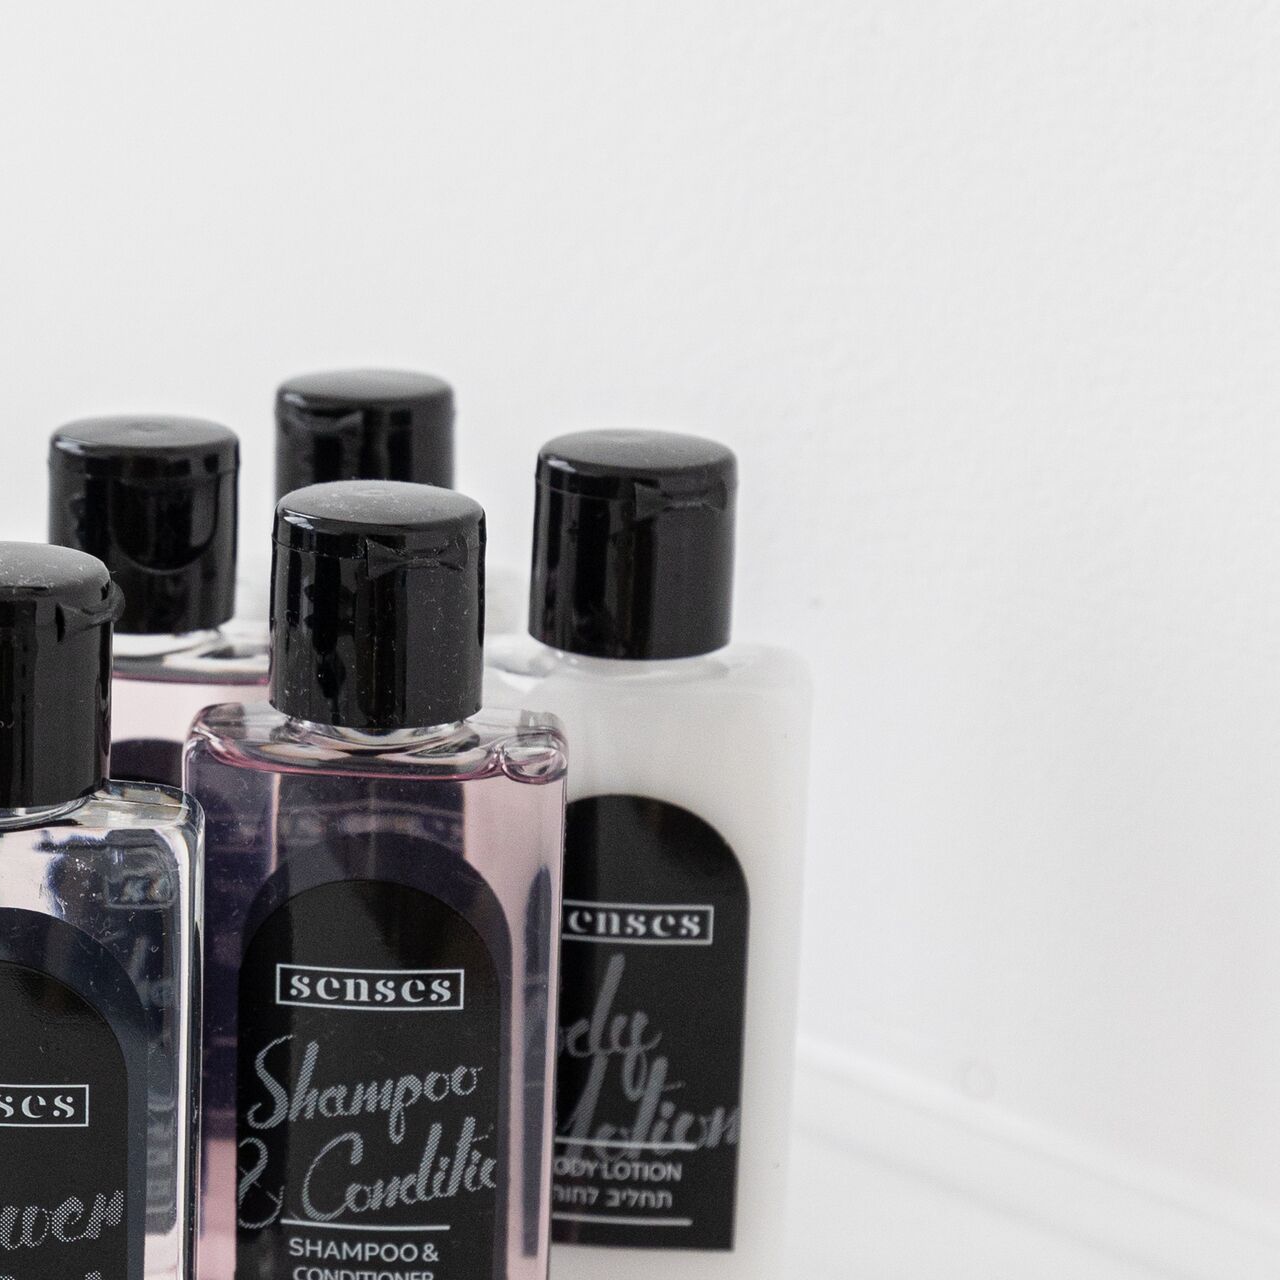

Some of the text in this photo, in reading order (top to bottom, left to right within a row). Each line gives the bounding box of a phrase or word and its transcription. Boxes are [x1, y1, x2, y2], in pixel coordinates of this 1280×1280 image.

[569, 910, 701, 938] enses
[290, 974, 452, 1004] senses
[247, 1034, 483, 1145] Shampoo
[553, 1158, 683, 1183] ODY LOTION
